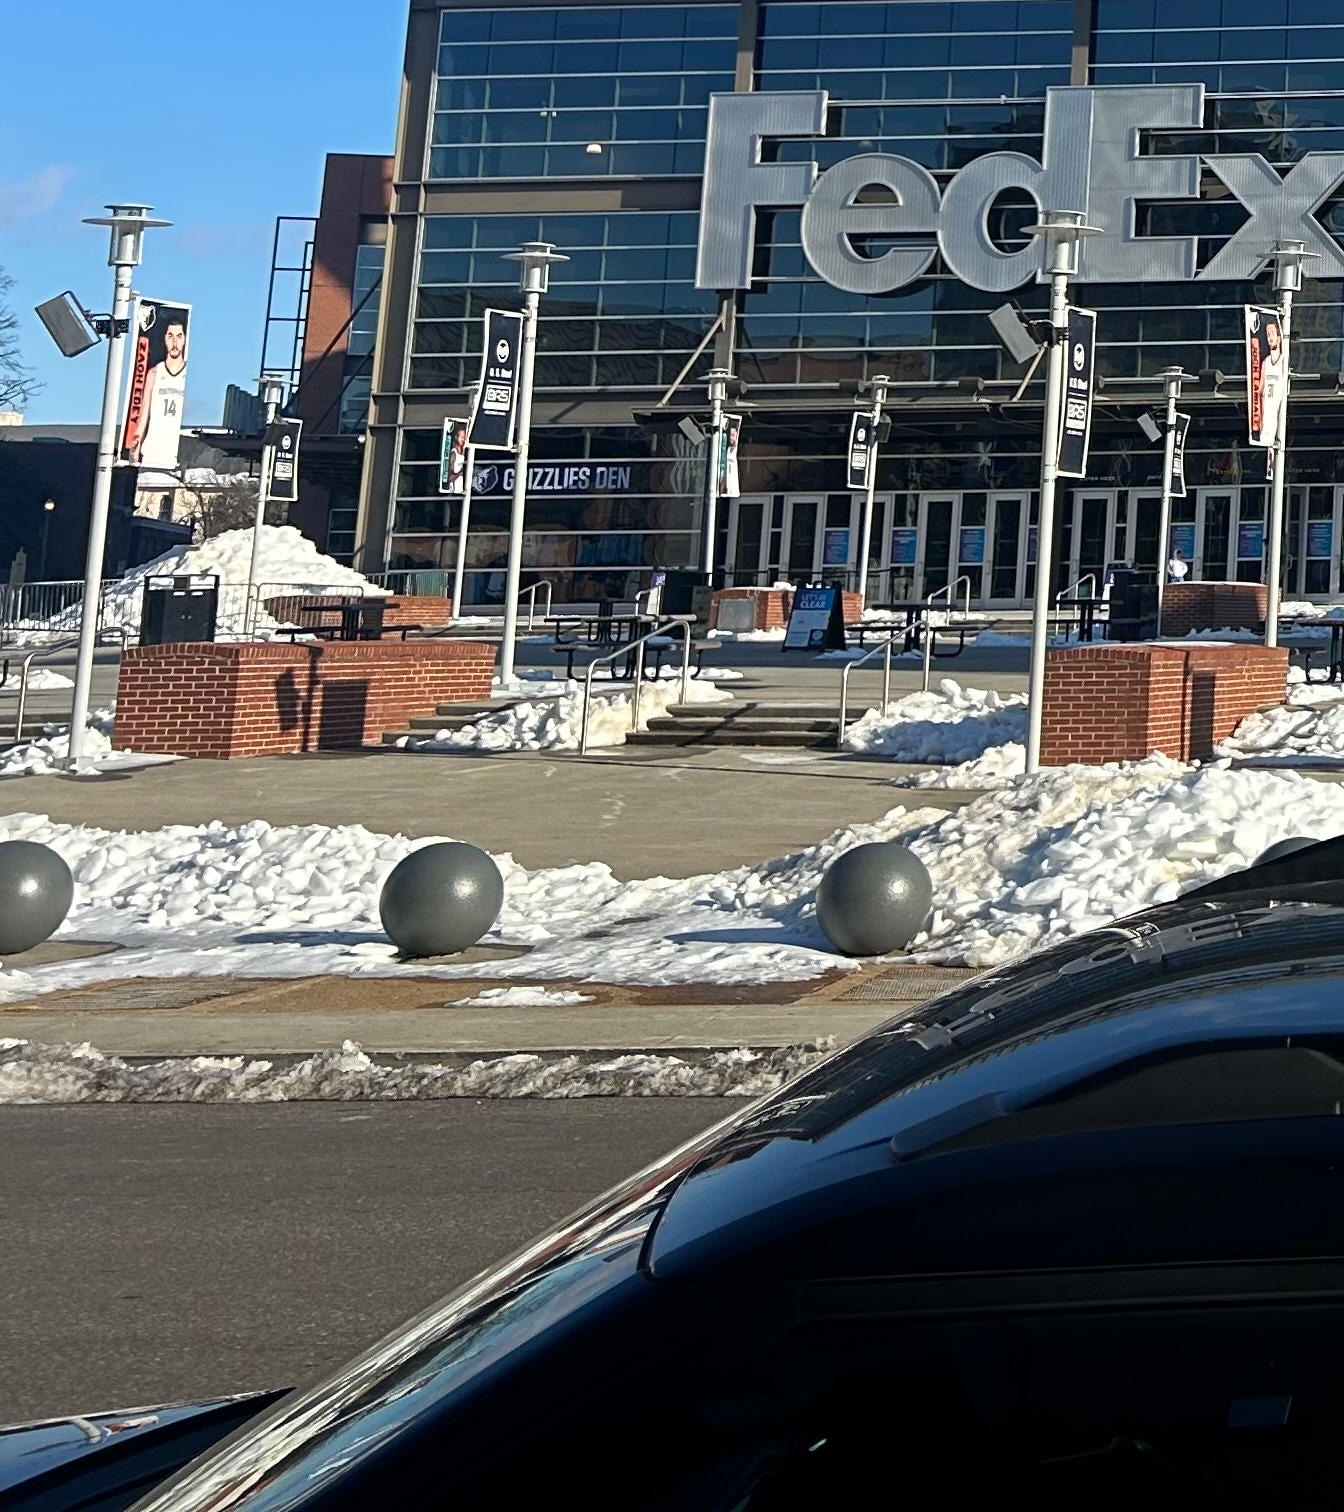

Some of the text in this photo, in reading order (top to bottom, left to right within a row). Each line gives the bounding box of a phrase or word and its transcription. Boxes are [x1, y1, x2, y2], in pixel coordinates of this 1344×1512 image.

[163, 398, 176, 416] 14
[502, 466, 631, 490] GIZZLIES DEN
[800, 600, 826, 608] CLEAR
